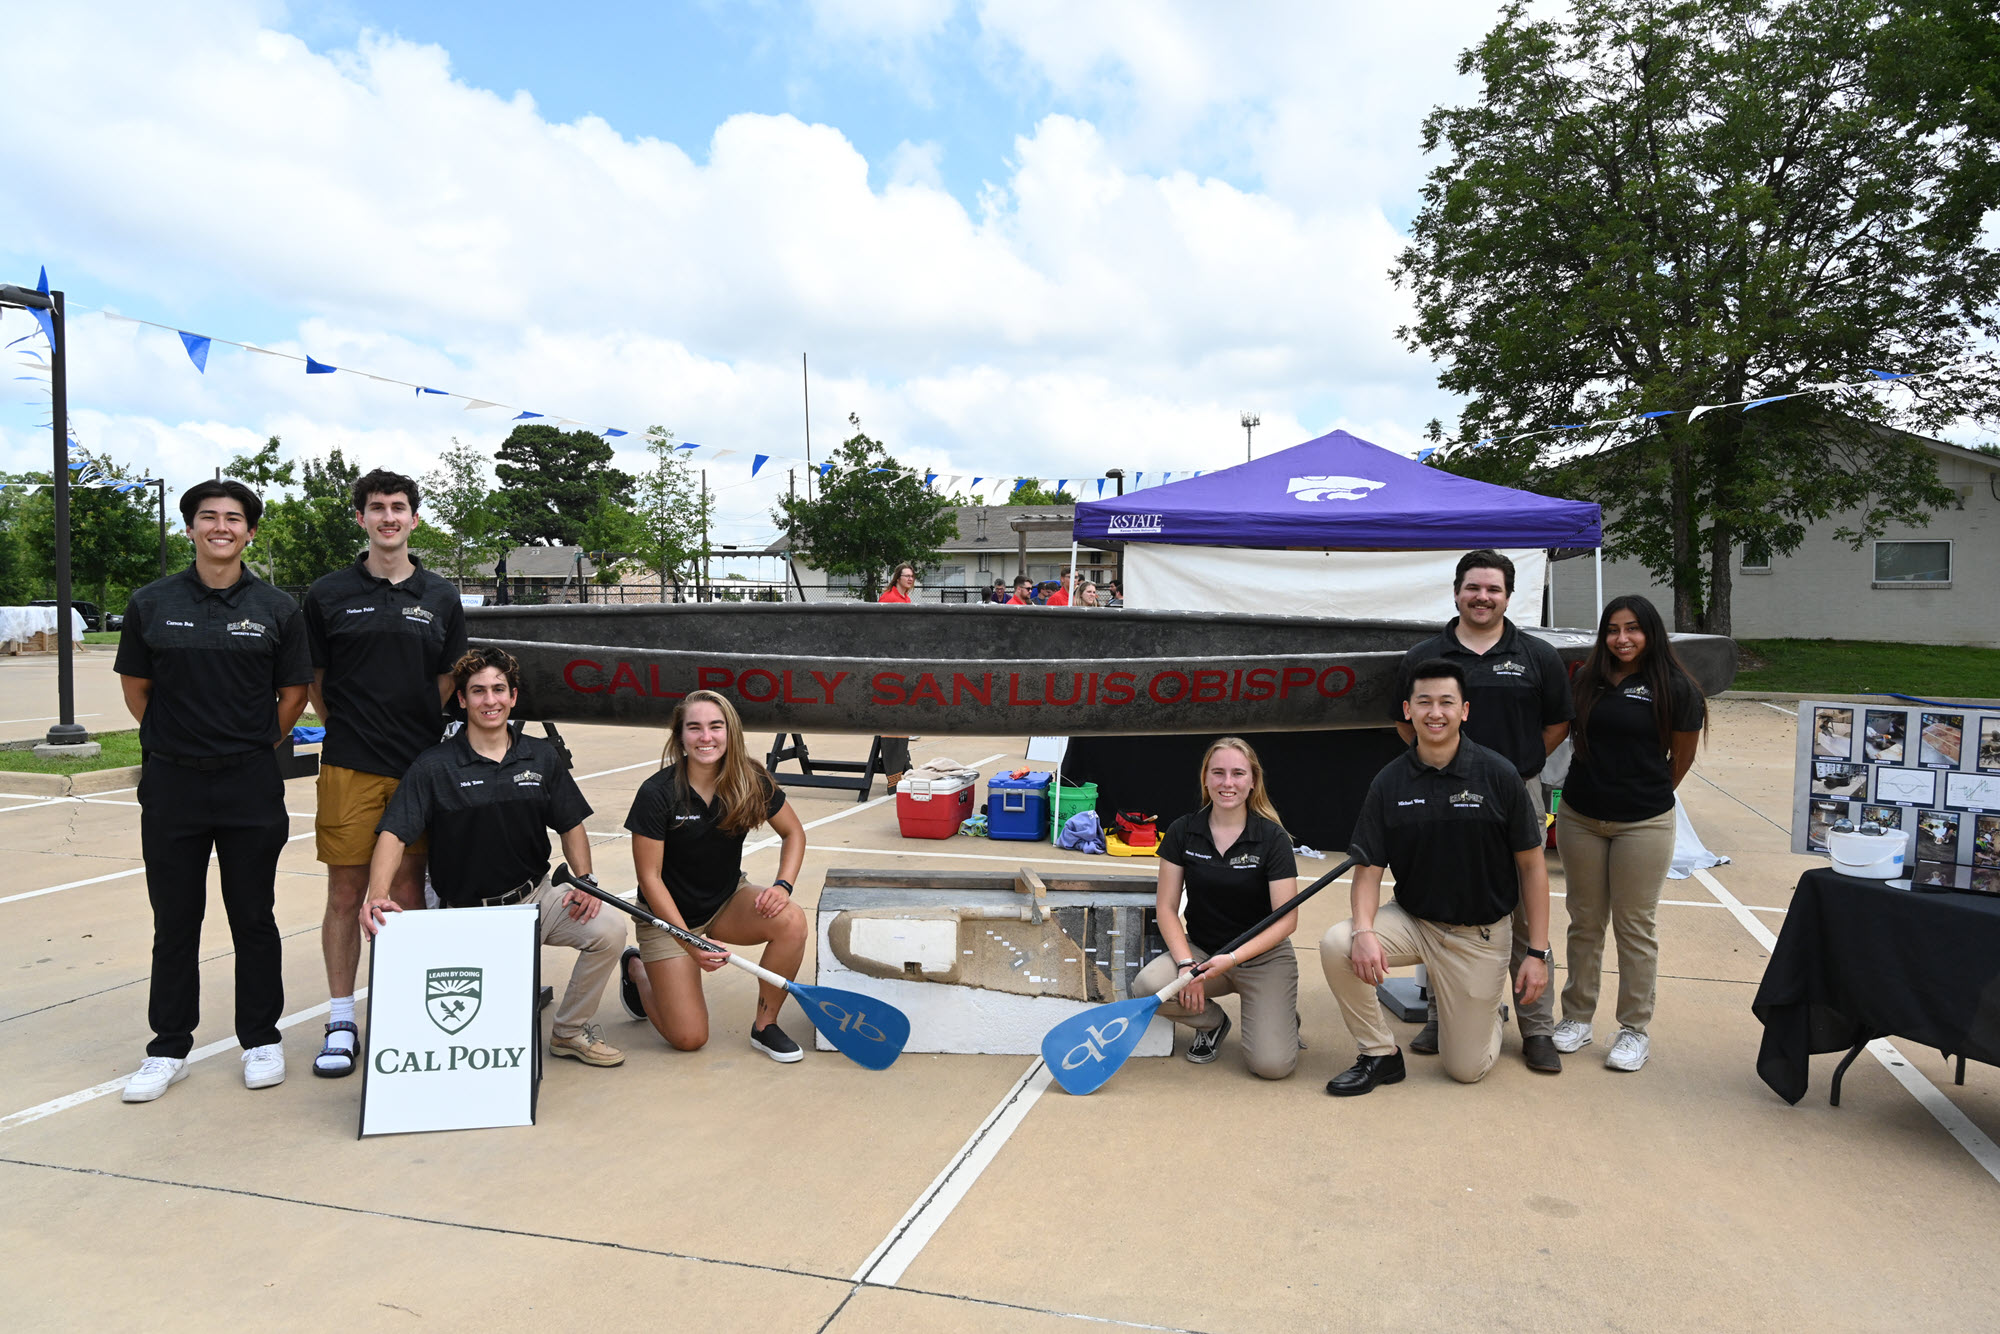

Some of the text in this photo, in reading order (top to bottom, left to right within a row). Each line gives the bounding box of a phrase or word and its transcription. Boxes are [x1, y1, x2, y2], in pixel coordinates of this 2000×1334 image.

[563, 659, 1356, 706] CAL POLY SAN LUIS OBISPO
[429, 971, 449, 979] LEARN
[375, 1046, 526, 1075] CAL POLY
